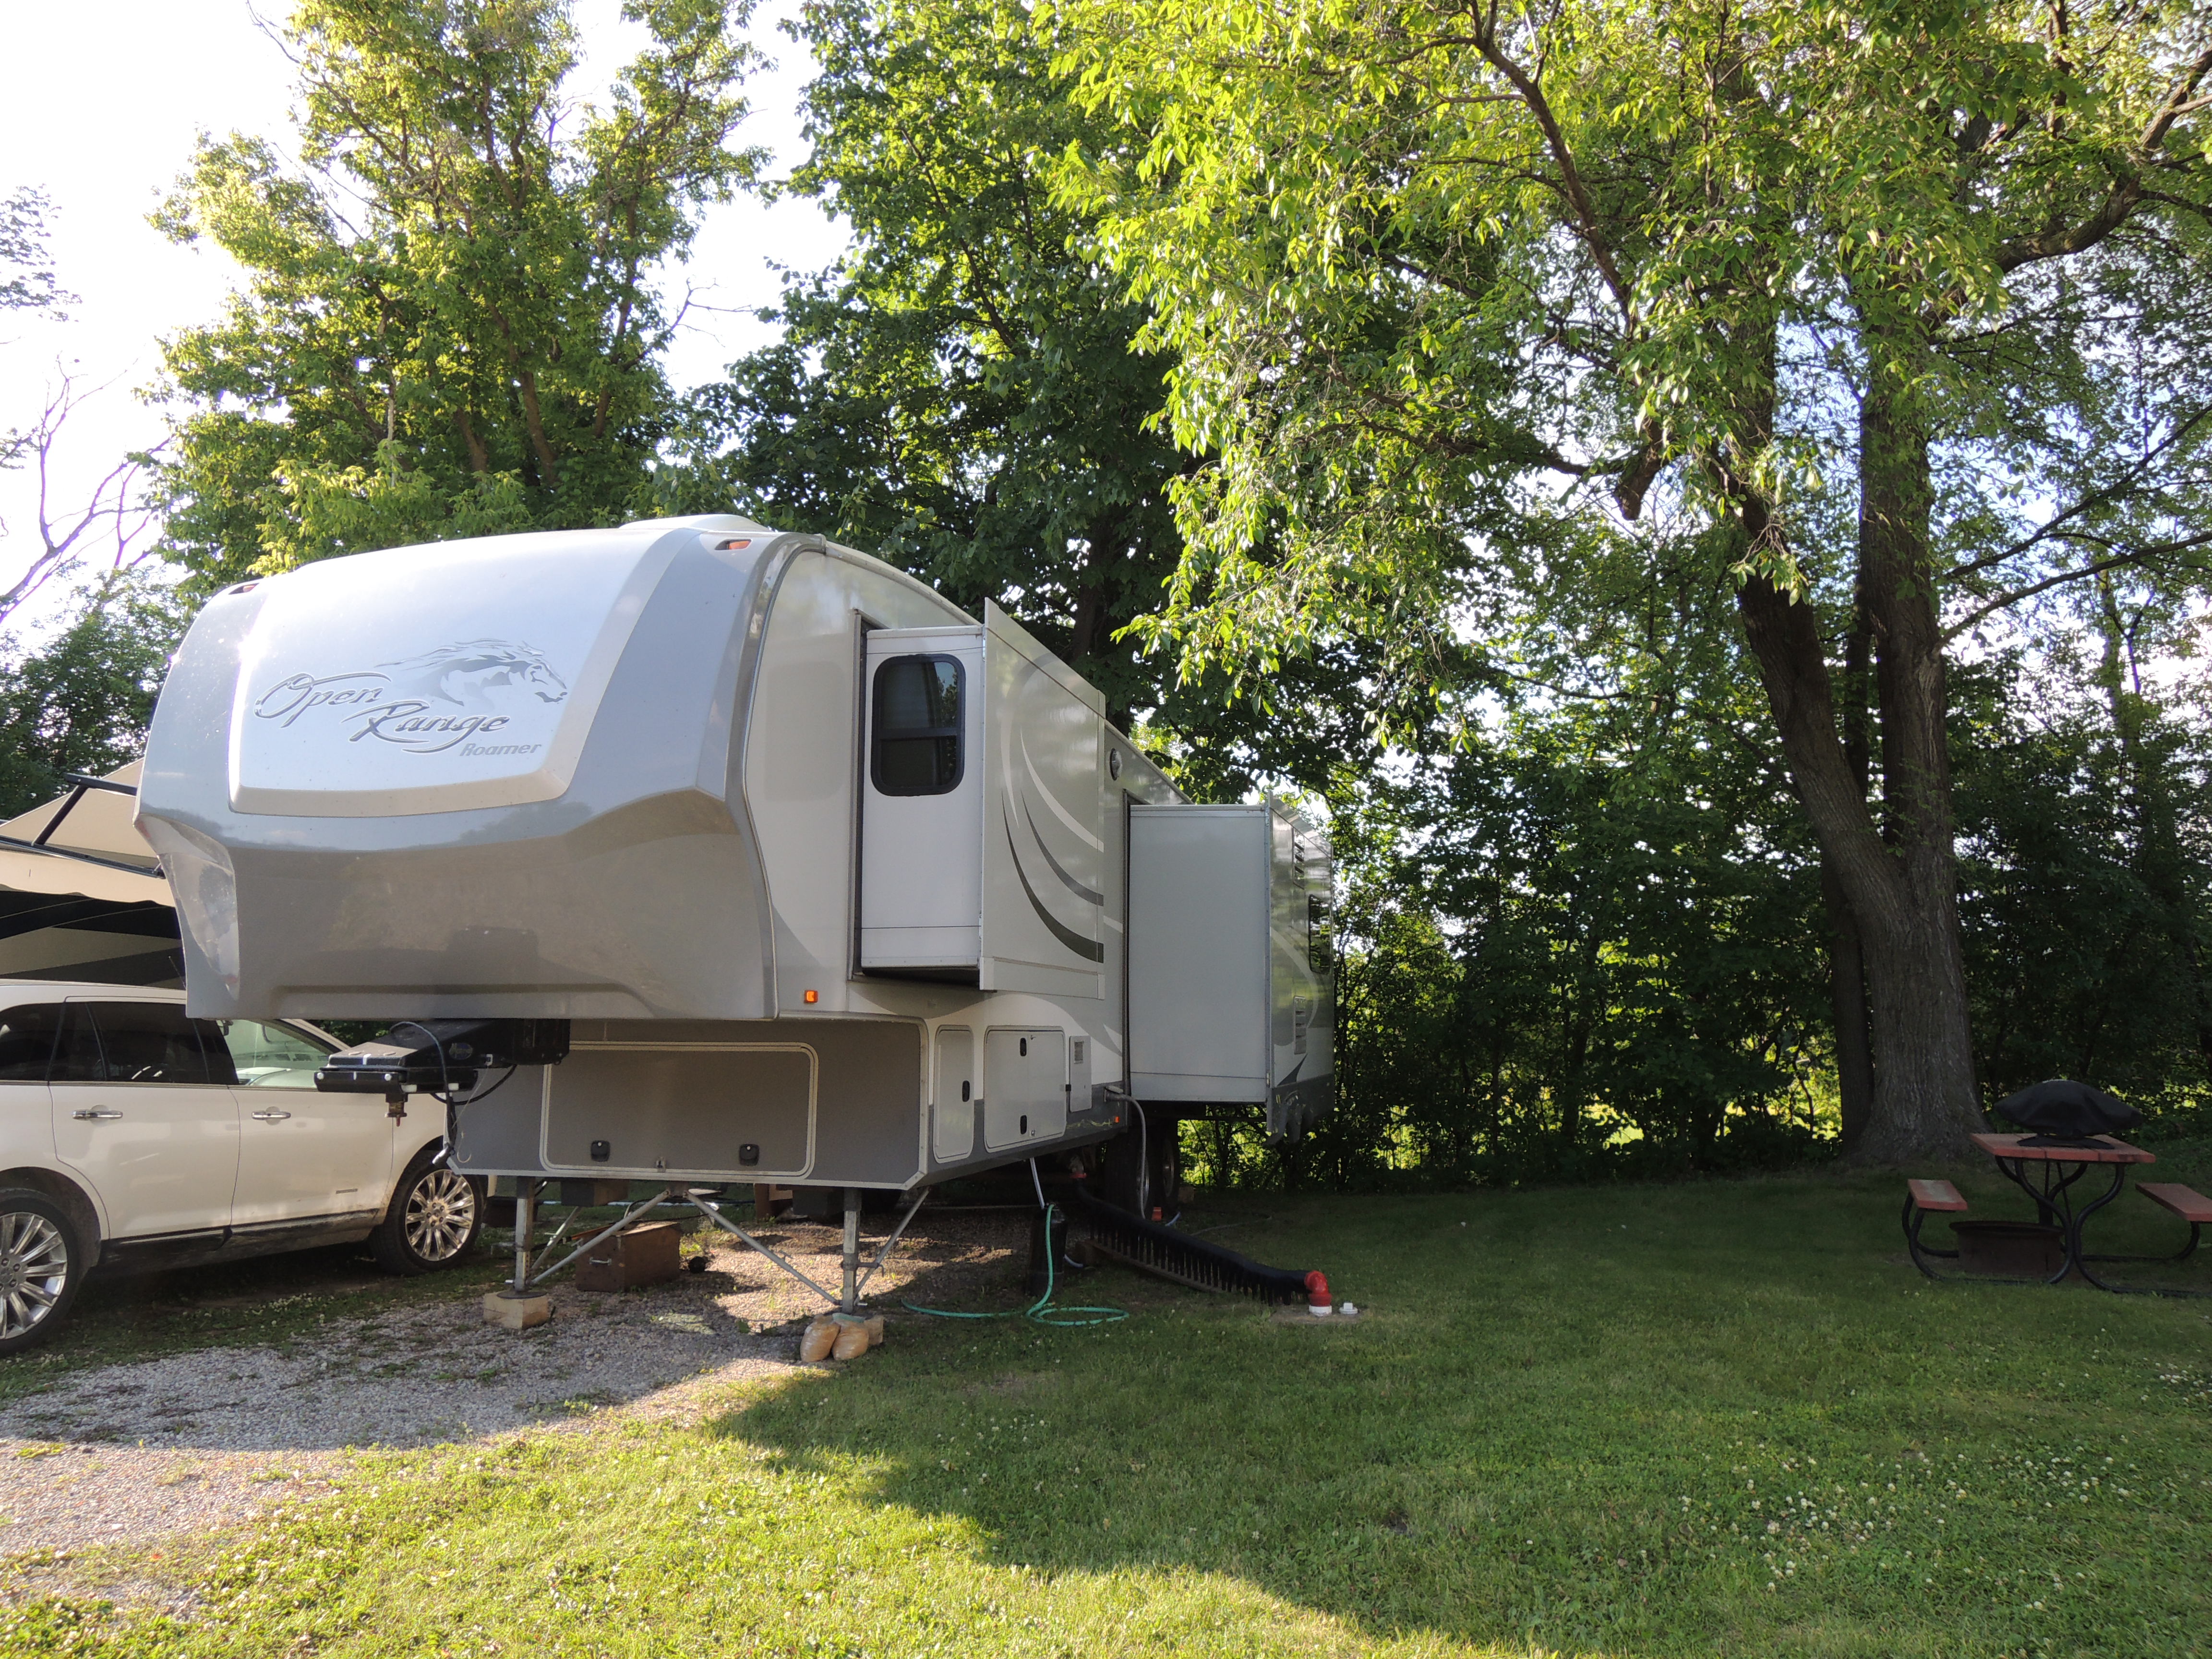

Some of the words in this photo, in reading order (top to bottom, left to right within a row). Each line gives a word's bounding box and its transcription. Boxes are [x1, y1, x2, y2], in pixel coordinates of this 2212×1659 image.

[254, 673, 392, 728] Open
[341, 700, 510, 754] Range
[459, 743, 541, 756] Roamer
